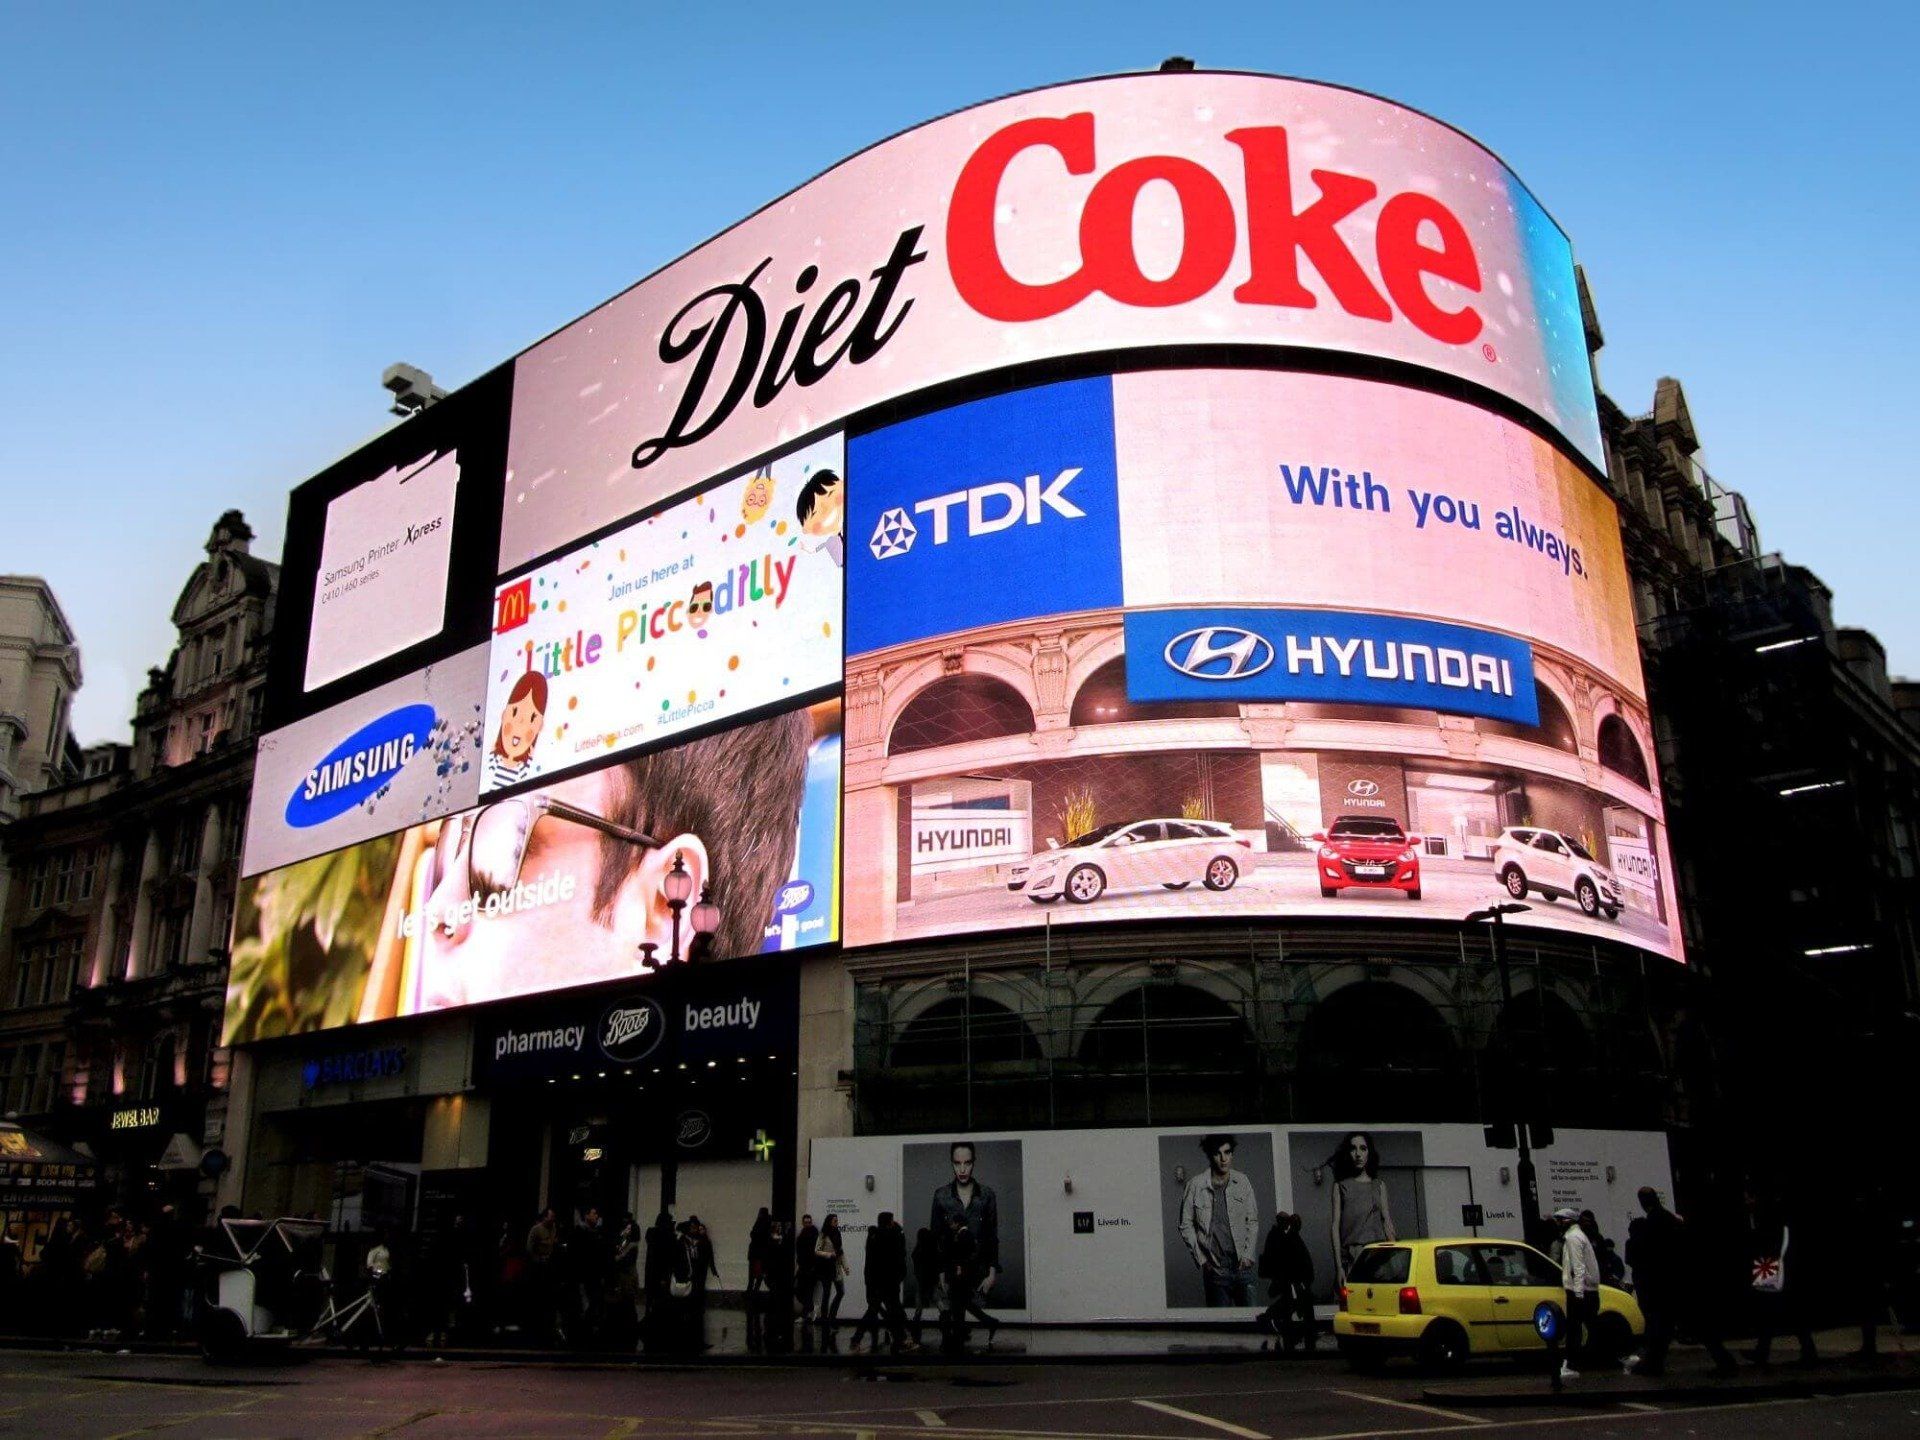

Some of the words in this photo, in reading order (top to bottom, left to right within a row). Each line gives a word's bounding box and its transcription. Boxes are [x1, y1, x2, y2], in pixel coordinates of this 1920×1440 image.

[631, 224, 927, 470] Diet
[944, 110, 1485, 347] Coke
[914, 467, 1088, 546] TDK
[1279, 464, 1391, 513] With
[1407, 489, 1481, 530] you
[1494, 505, 1588, 581] always.
[323, 557, 366, 587] Samsung
[367, 538, 401, 565] Printer
[403, 517, 442, 546] Xpress
[608, 582, 634, 602] Join
[635, 576, 649, 590] us
[651, 563, 680, 585] here
[682, 554, 695, 571] at
[1286, 635, 1514, 697] HYUNDAI
[303, 732, 416, 801] SAMSUNG
[1343, 797, 1387, 808] HYUNDAI
[917, 828, 1012, 853] HYUNDAI
[444, 889, 481, 937] get
[485, 869, 577, 918] outside
[602, 1007, 650, 1047] Boots
[684, 996, 761, 1031] beauty
[322, 1046, 406, 1085] BARCLAYS
[494, 1025, 586, 1061] pharmacy
[1097, 1218, 1119, 1226] Lived
